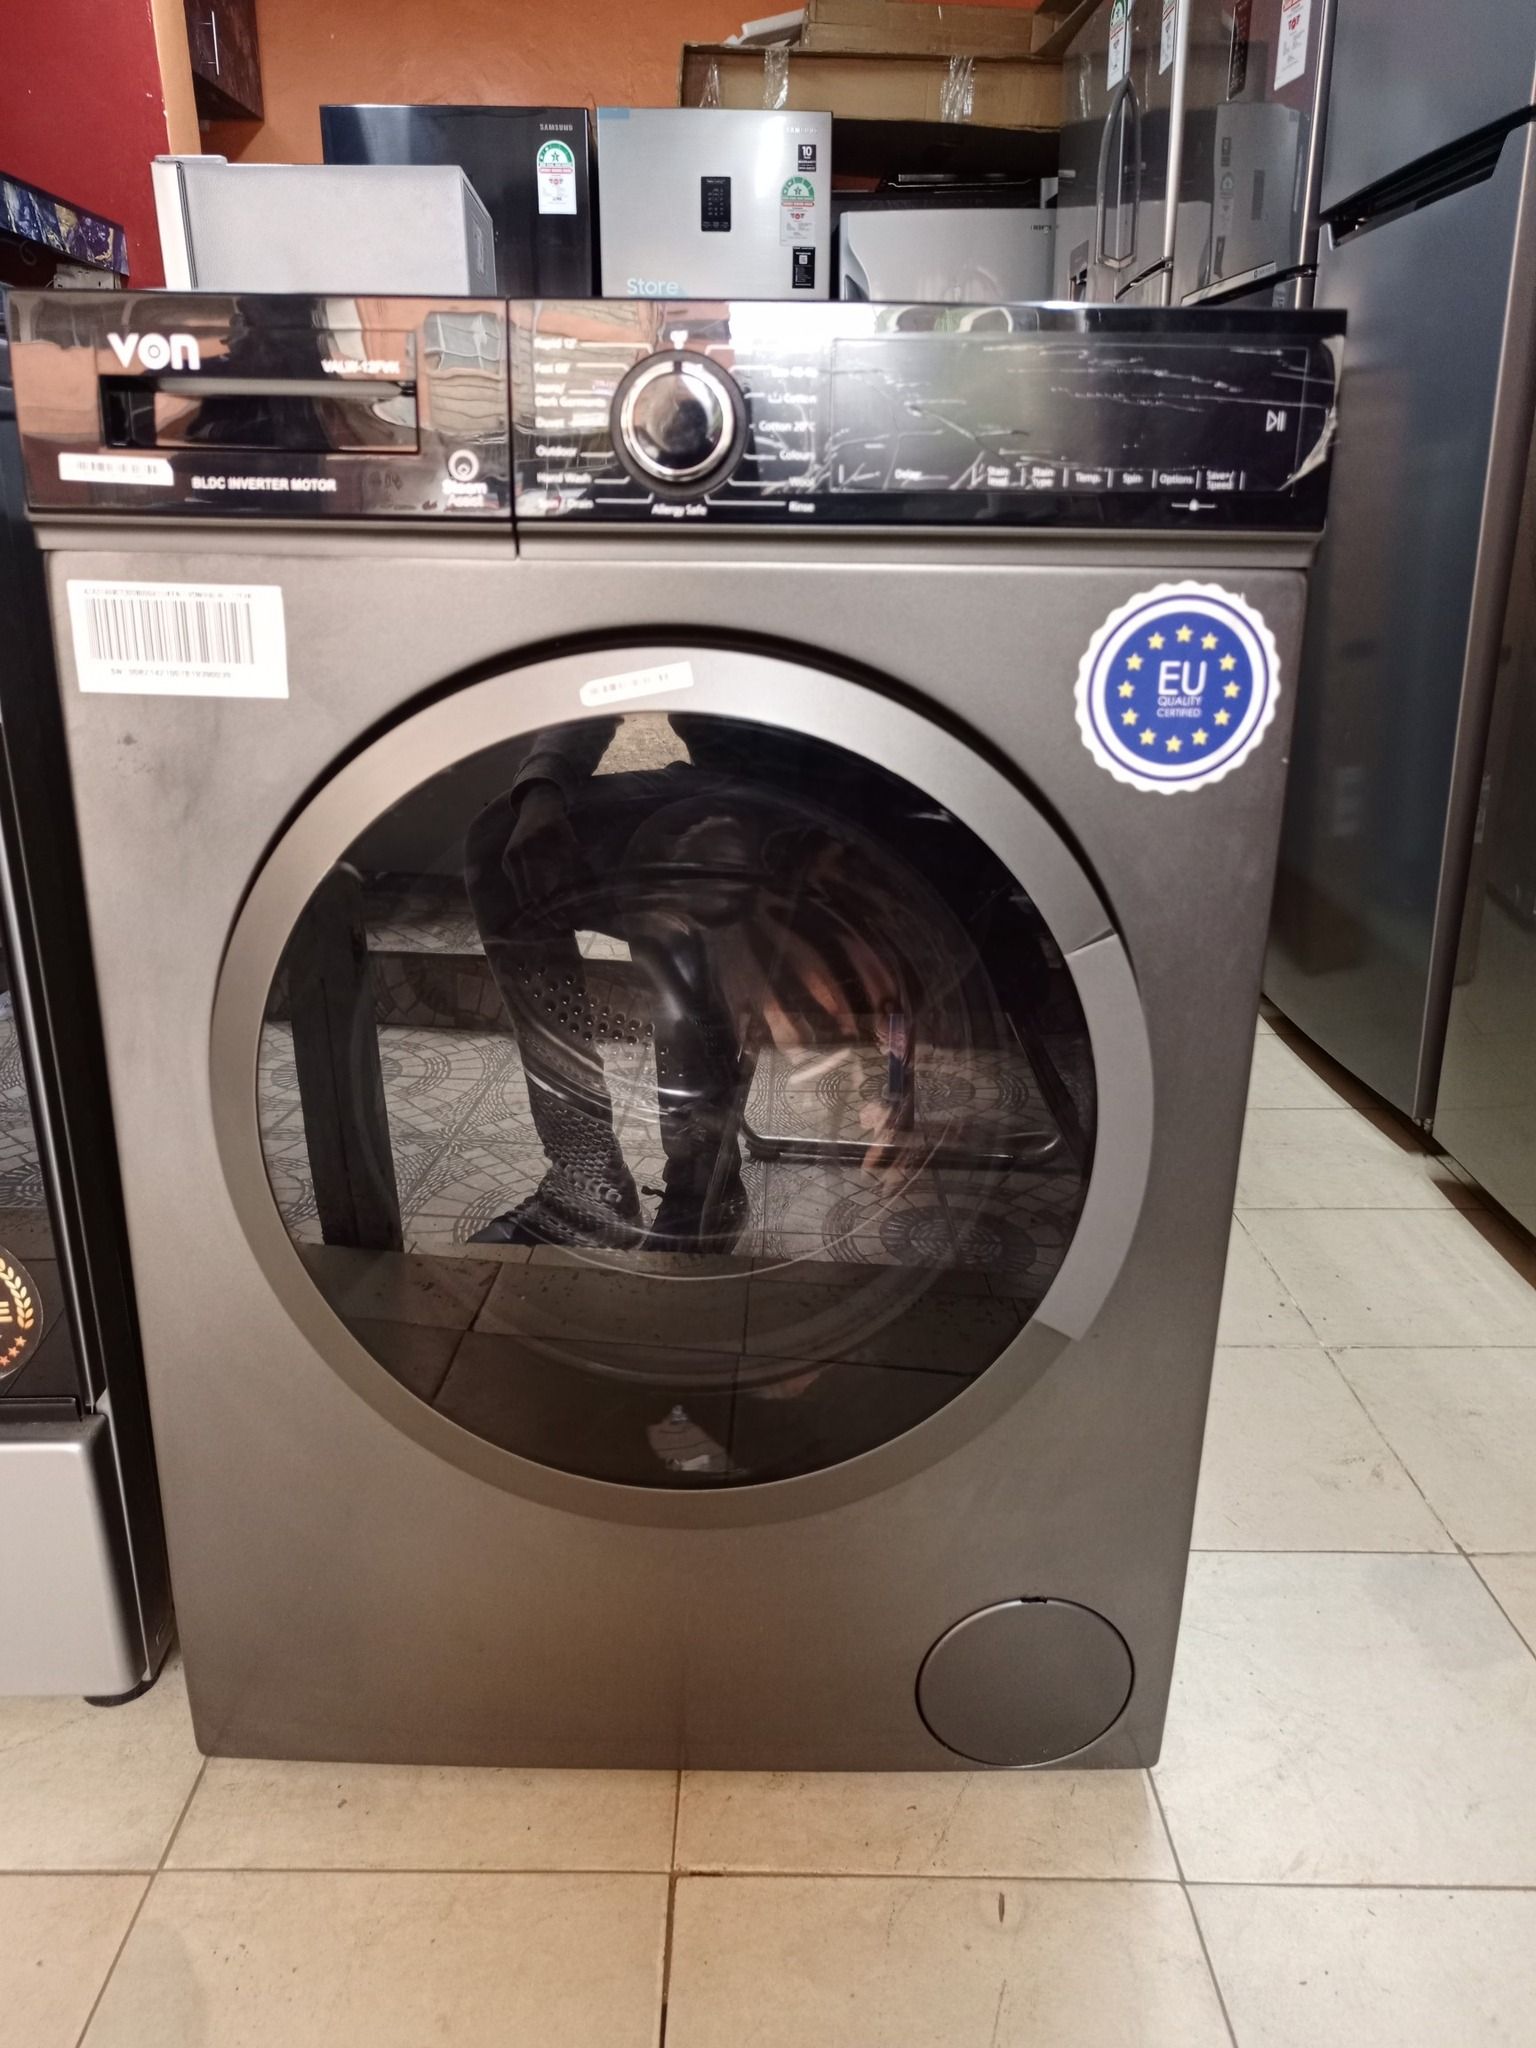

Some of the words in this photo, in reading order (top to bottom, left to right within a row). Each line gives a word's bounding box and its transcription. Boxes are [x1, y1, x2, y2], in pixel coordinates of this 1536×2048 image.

[539, 123, 574, 131] SAMSUNG
[801, 146, 813, 156] 10
[627, 278, 679, 295] Store
[107, 333, 200, 370] von
[758, 421, 792, 432] Cotton
[779, 449, 815, 461] Colours
[192, 476, 226, 490] BLDC
[228, 476, 290, 491] INVERTER
[290, 478, 337, 492] MOTOR
[536, 472, 563, 484] Hand
[564, 472, 592, 485] Wash
[1122, 472, 1143, 485] Spin
[1159, 473, 1195, 486] Options
[442, 479, 488, 495] Steam
[1206, 480, 1234, 492] Speed
[651, 503, 685, 518] Allergy
[685, 504, 708, 516] Safe
[788, 501, 816, 513] Rinse
[1158, 660, 1208, 696] EU
[1157, 695, 1202, 708] QUALITY
[1156, 708, 1202, 718] CERTIFIED
